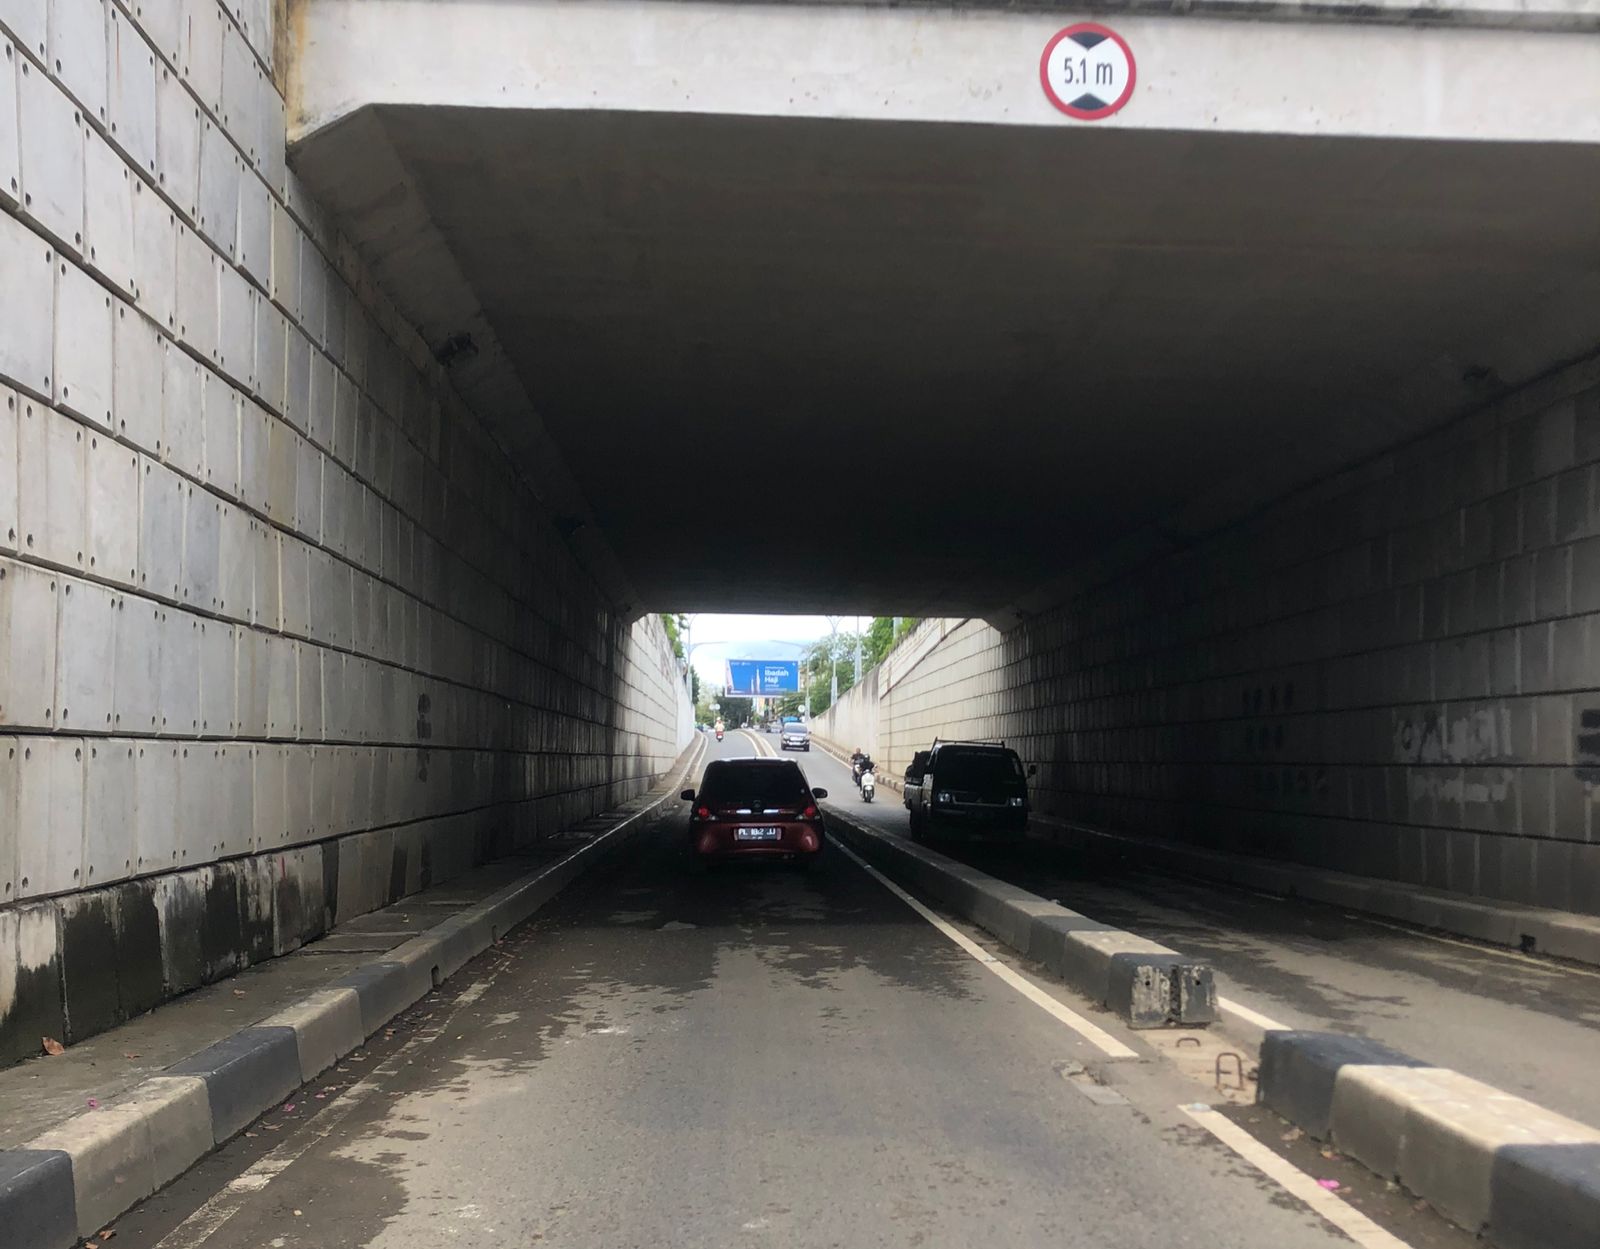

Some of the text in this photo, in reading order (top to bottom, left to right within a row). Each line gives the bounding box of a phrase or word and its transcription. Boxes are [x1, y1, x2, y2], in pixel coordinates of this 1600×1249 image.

[1064, 57, 1113, 85] 5.1 m
[764, 669, 789, 677] Ibadah
[764, 677, 778, 685] Haji
